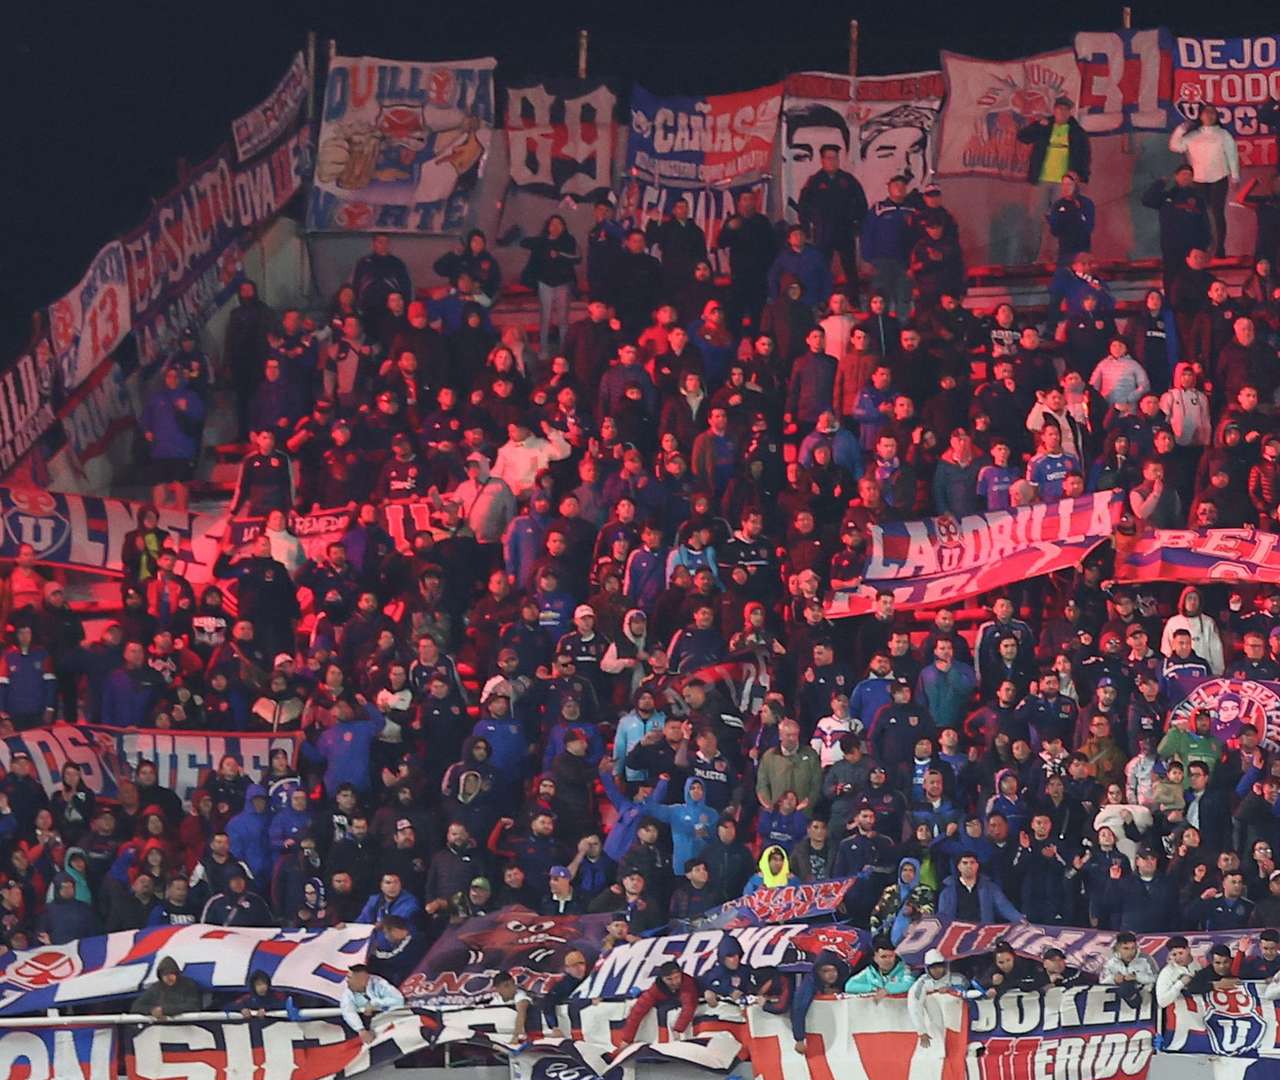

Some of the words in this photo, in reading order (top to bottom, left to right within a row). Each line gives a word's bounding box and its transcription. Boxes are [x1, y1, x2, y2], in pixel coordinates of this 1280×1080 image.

[1076, 30, 1168, 133] 31
[1178, 36, 1278, 70] DEJO
[506, 83, 617, 197] 89
[653, 100, 757, 154] CAÑAS
